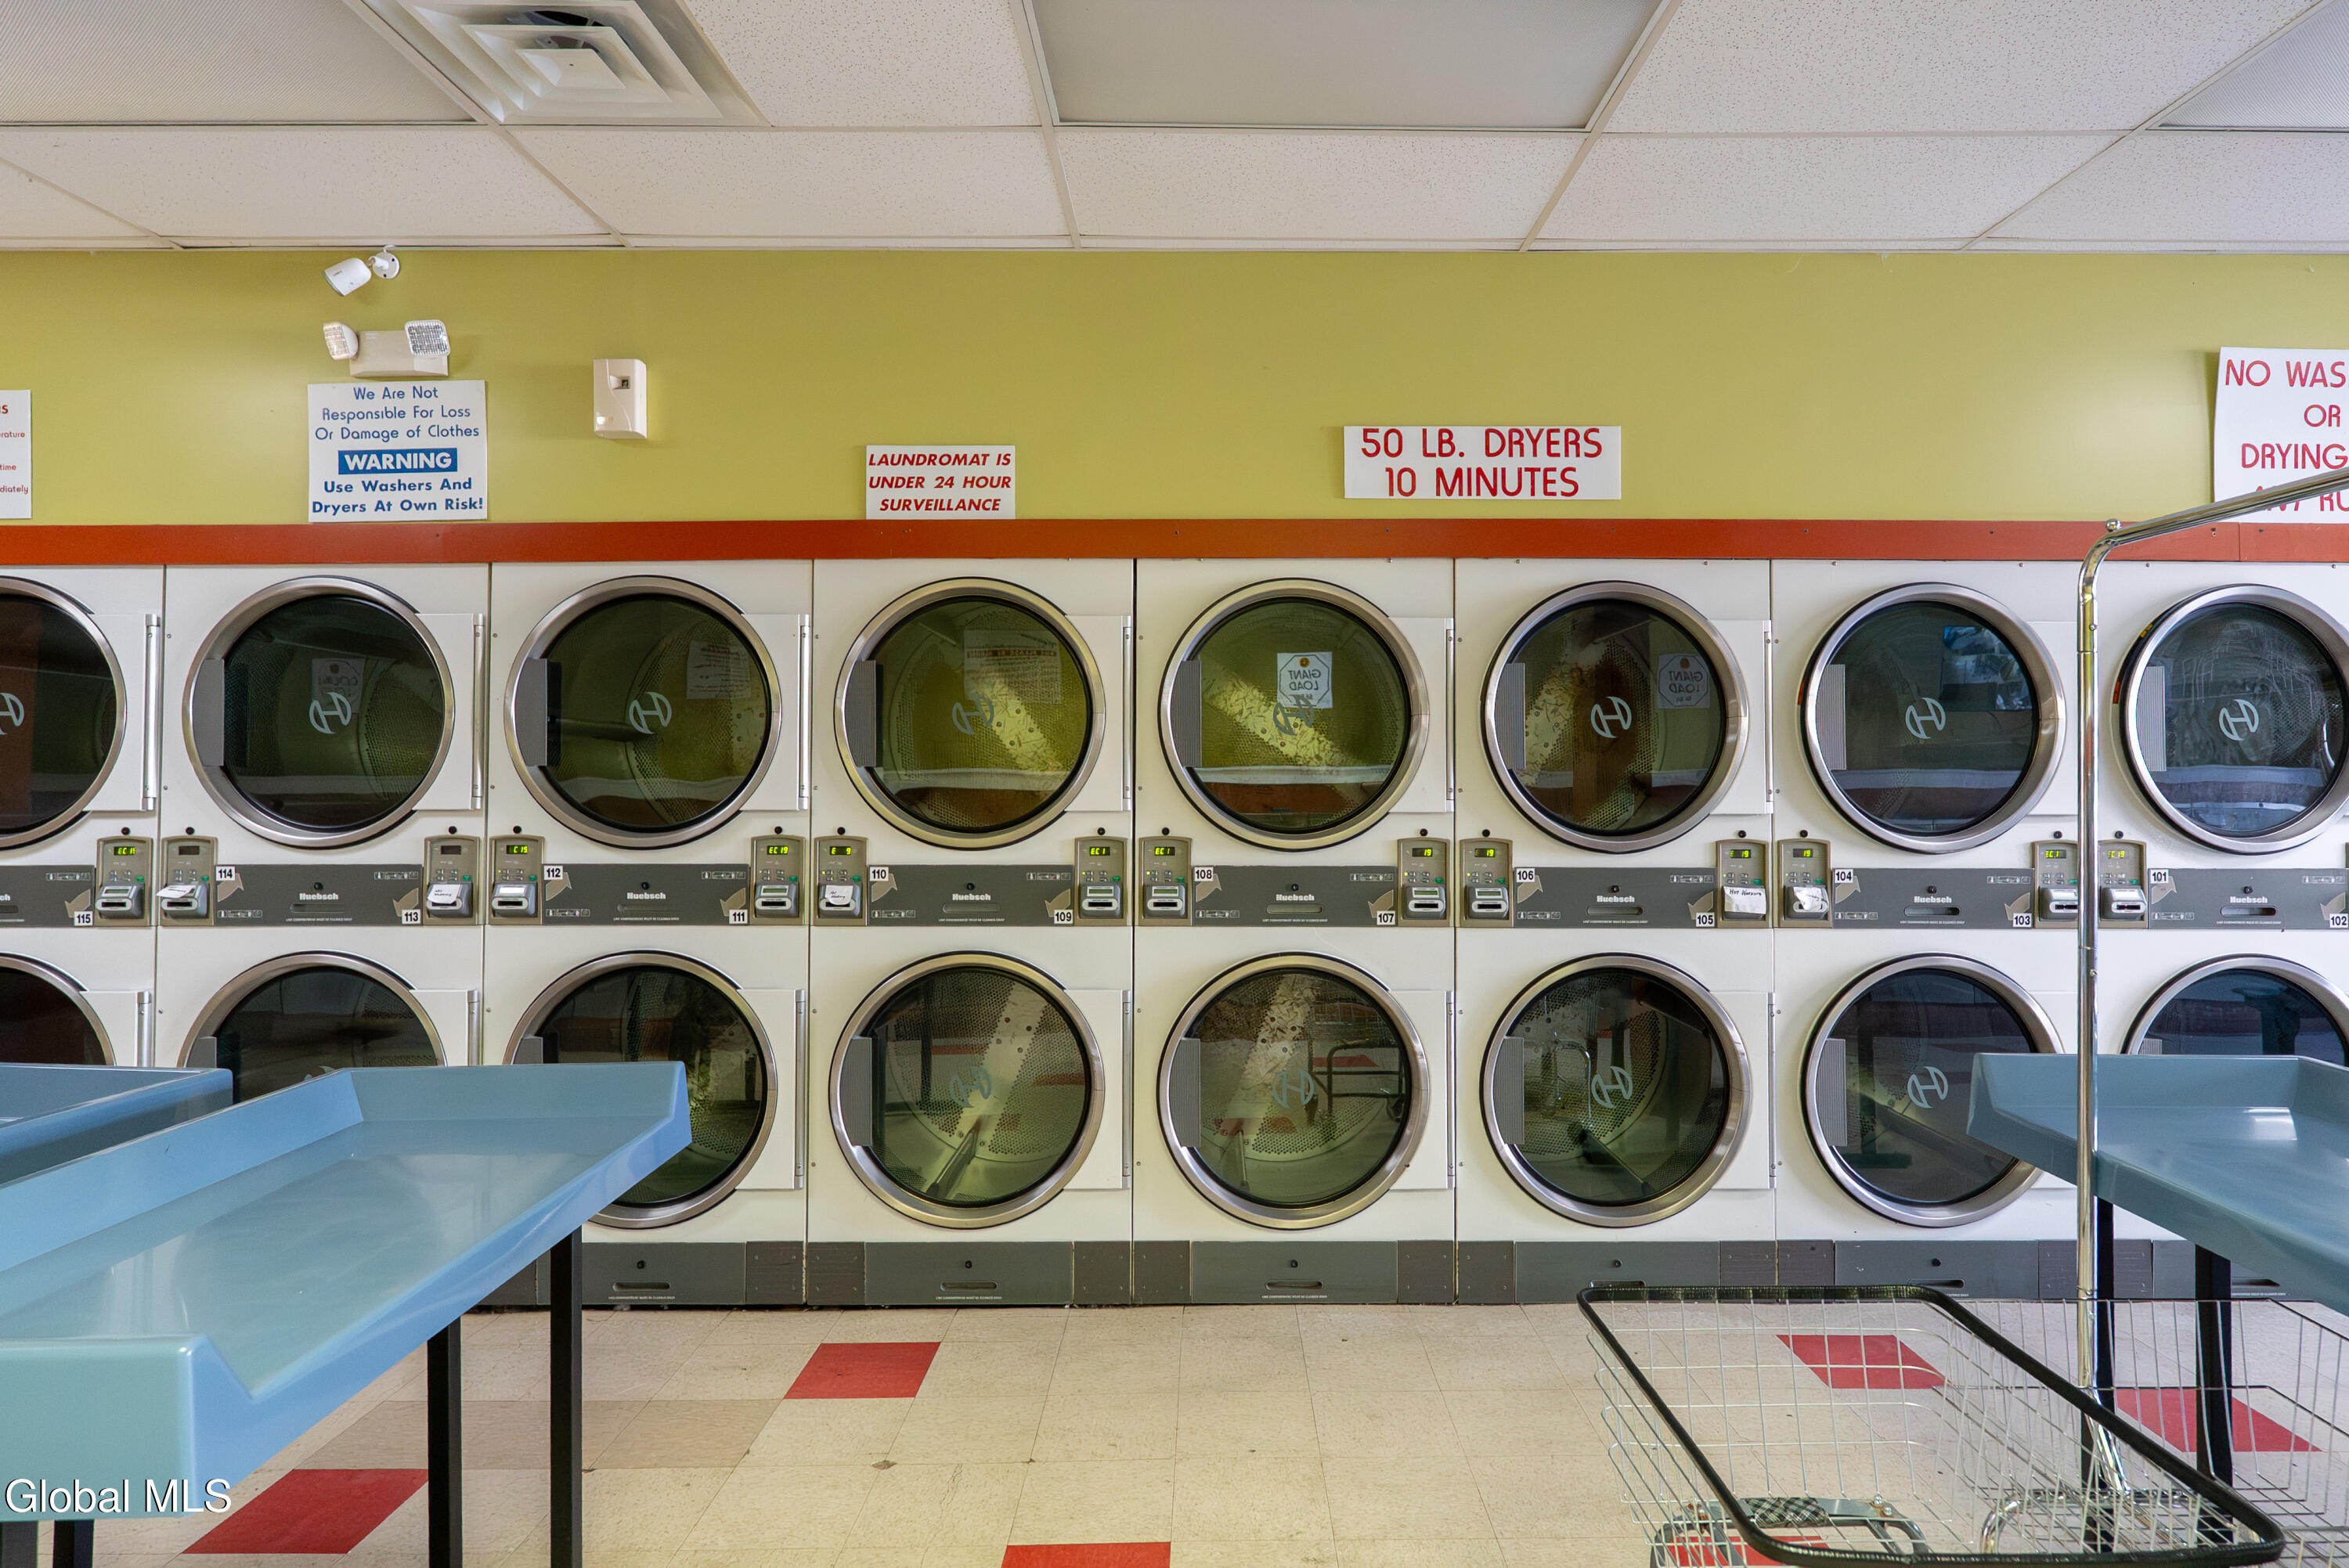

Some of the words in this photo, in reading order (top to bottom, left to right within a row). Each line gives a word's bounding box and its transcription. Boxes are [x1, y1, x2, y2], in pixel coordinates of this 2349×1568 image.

[2225, 359, 2271, 387] NO
[2286, 361, 2349, 387] WAS
[353, 387, 375, 400] We
[382, 387, 406, 399] Are
[413, 386, 438, 398] Not
[0, 404, 9, 414] S
[323, 406, 406, 424] Responsible
[413, 406, 434, 418] For
[442, 405, 471, 417] Loss
[2304, 404, 2341, 427] OR
[315, 427, 334, 440] Or
[341, 427, 399, 443] Damage
[406, 425, 421, 438] of
[428, 424, 479, 437] Clothes
[1361, 428, 1403, 458] 50
[1422, 428, 1465, 458] LB.
[1485, 427, 1603, 458] DRYERS
[345, 452, 453, 470] WARNING
[868, 453, 990, 466] LAUNDROMAT
[996, 453, 1011, 466] IS
[2242, 443, 2348, 470] DRYING
[324, 481, 353, 493] Use
[361, 478, 432, 492] Washers
[440, 478, 472, 490] And
[868, 476, 925, 488] UNDER
[933, 476, 954, 488] 24
[962, 476, 1012, 488] HOUR
[1385, 467, 1416, 497] 10
[1436, 467, 1579, 497] MINUTES
[312, 501, 366, 516] Dryers
[374, 500, 392, 512] At
[400, 499, 437, 511] Own
[445, 497, 484, 510] Risk!
[879, 499, 1001, 511] SURVEILLANCE
[218, 869, 233, 879] 114
[547, 868, 561, 878] 112
[871, 869, 886, 879] 110
[1195, 870, 1212, 880] 108
[1517, 871, 1534, 881] 106
[1835, 871, 1852, 881] 104
[2152, 872, 2167, 881] 101
[77, 914, 91, 924] 115
[404, 912, 418, 922] 113
[732, 912, 745, 922] 111
[1055, 912, 1071, 922] 109
[1378, 913, 1394, 923] 107
[1697, 914, 1713, 925] 105
[2014, 915, 2030, 925] 103
[2331, 916, 2347, 926] 102
